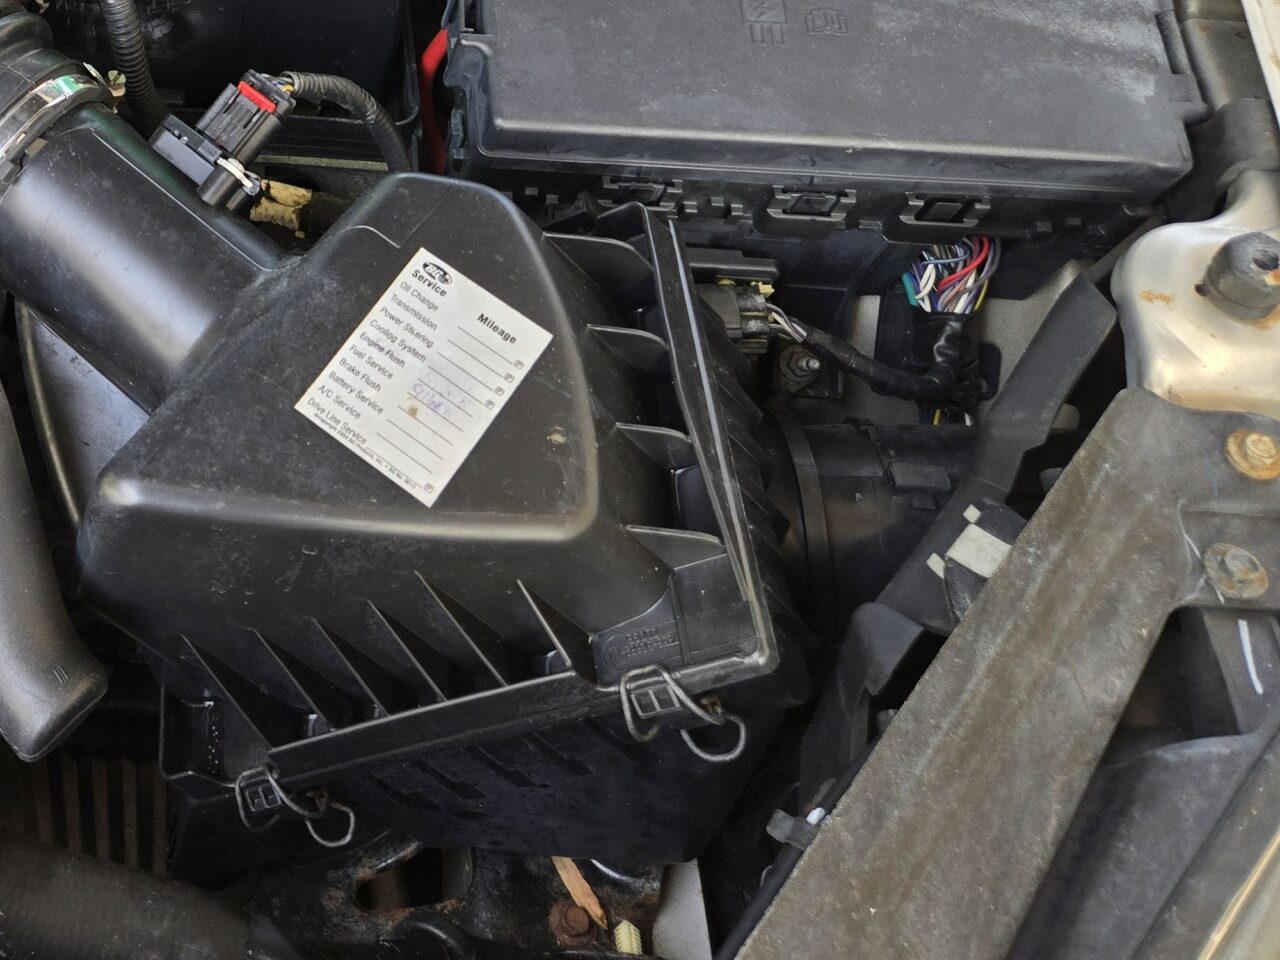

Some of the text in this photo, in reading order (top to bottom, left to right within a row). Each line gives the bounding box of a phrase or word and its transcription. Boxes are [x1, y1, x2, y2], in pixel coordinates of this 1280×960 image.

[390, 293, 437, 330] Transmission
[399, 281, 411, 292] Oil
[410, 288, 438, 311] Change
[411, 268, 516, 344] Service Mileage
[369, 319, 397, 343] Cooling
[397, 338, 426, 362] System
[379, 305, 403, 326] Power
[402, 322, 434, 348] Steering
[348, 344, 393, 379] Fuel Service
[359, 331, 405, 368] Engine Flush
[328, 370, 383, 414] Battery Service
[338, 357, 381, 392] Brake Flush
[307, 396, 325, 414] Drive
[324, 410, 340, 425] Line
[340, 421, 366, 444] Service
[317, 384, 360, 419] A/C Service
